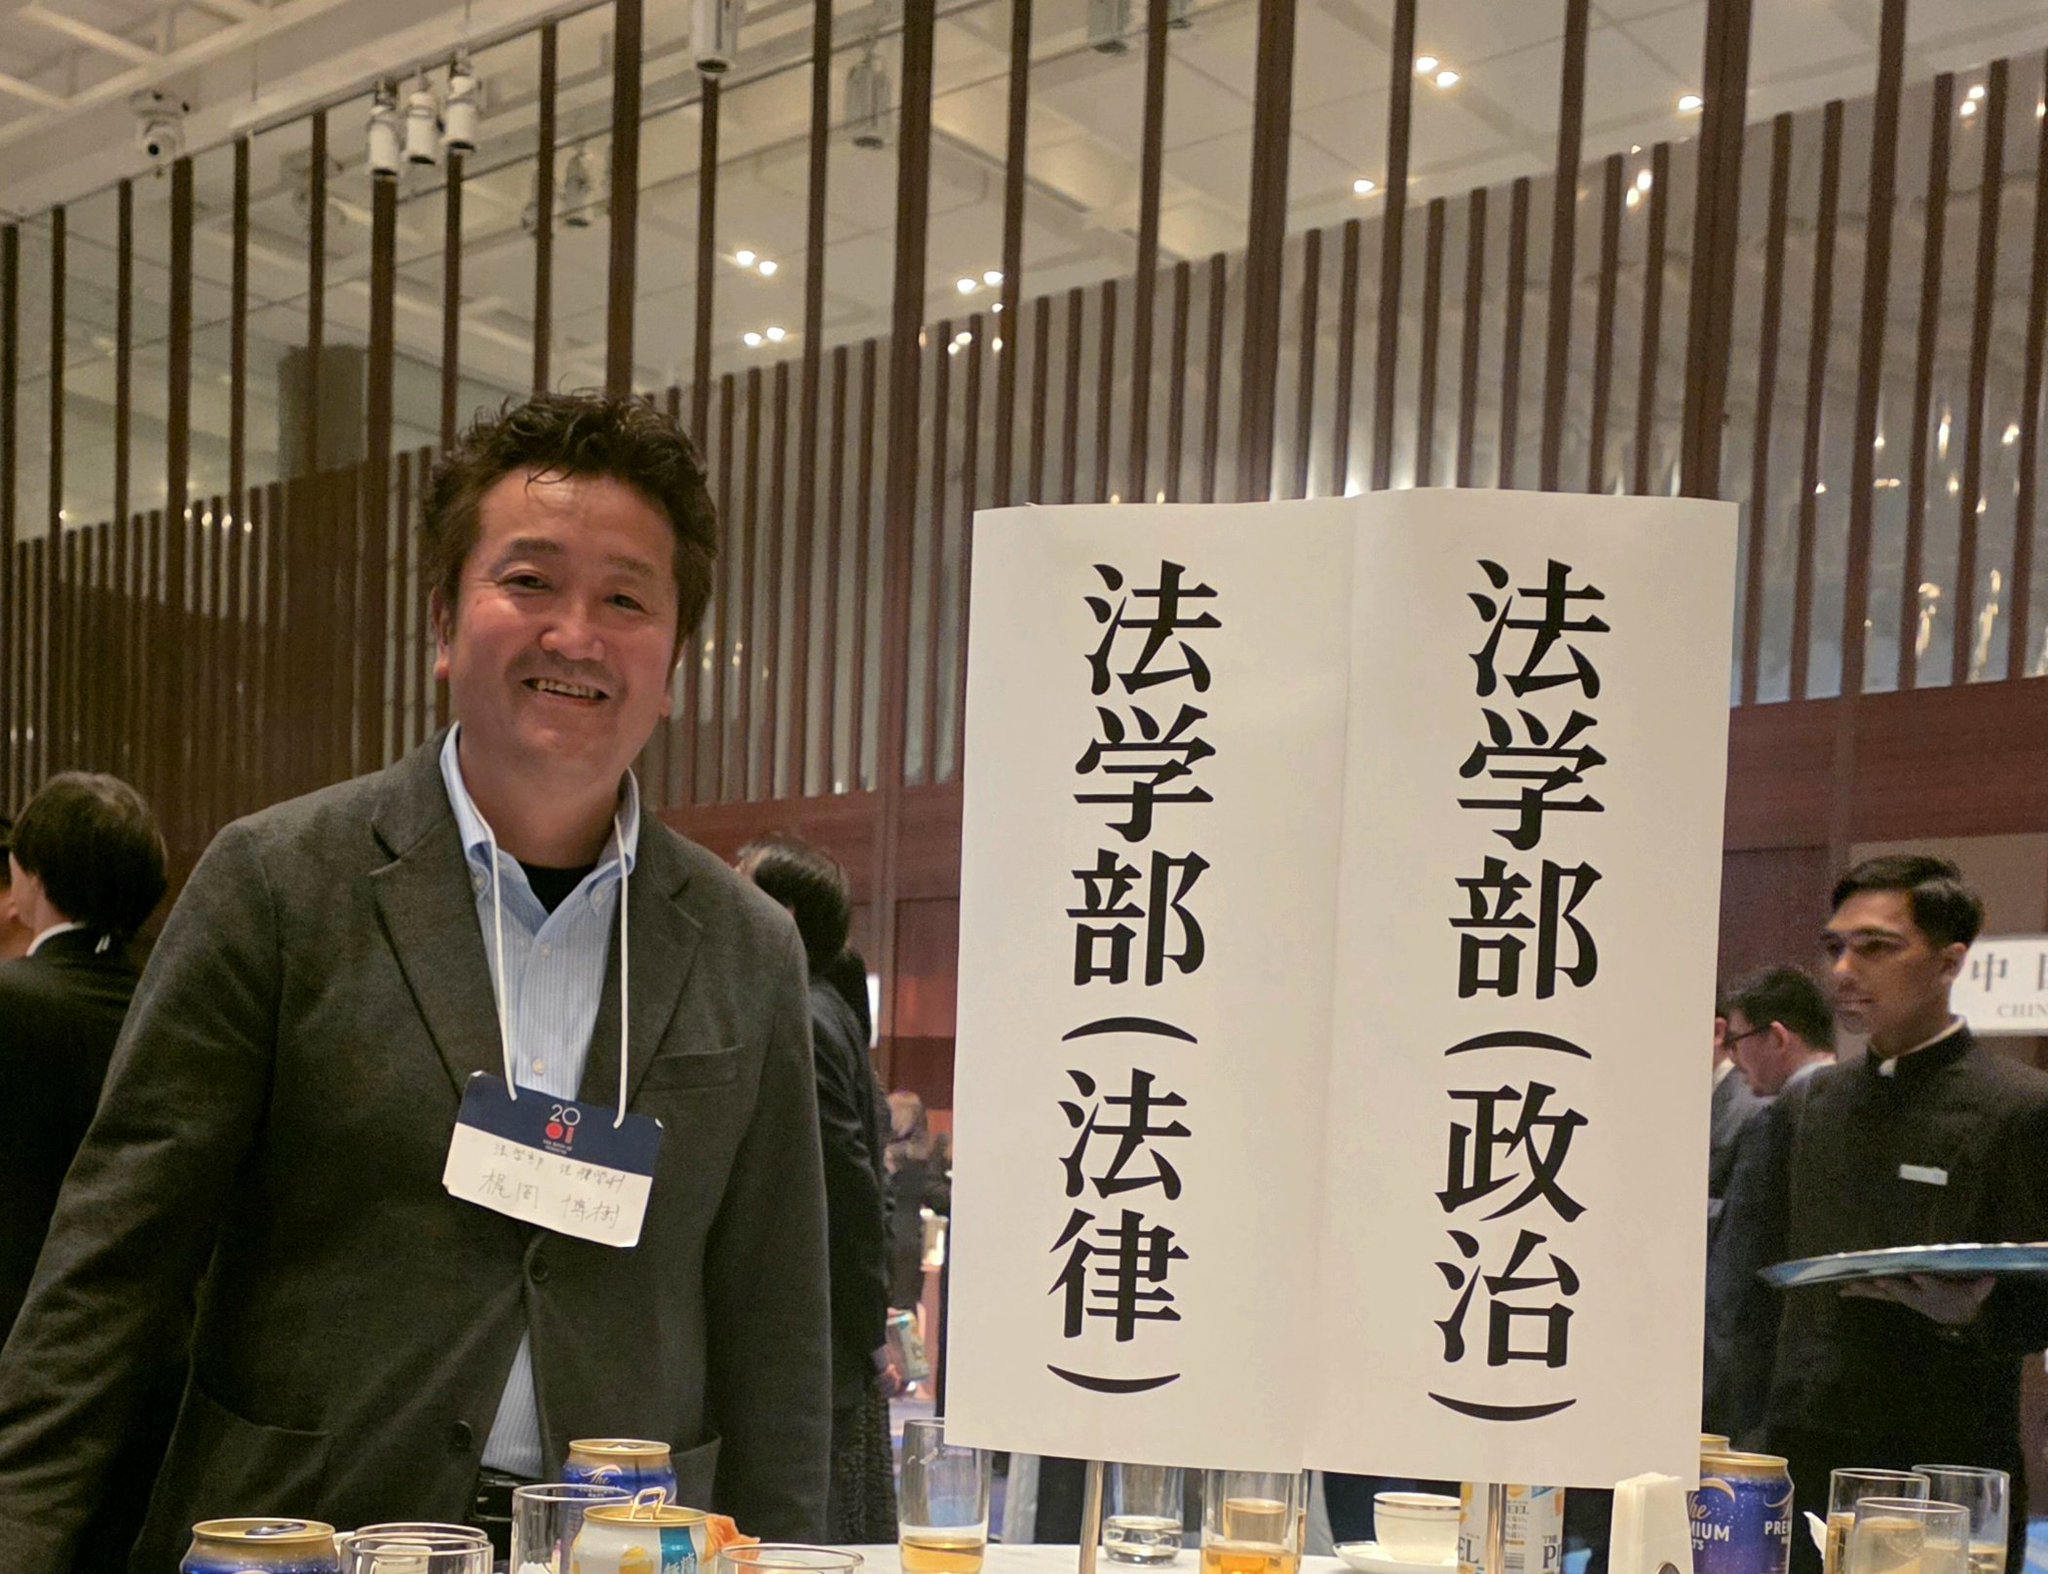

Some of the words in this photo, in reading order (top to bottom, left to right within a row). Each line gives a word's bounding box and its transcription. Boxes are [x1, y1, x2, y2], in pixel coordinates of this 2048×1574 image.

[1047, 560, 1222, 1394] 法学部（法律）
[1428, 559, 1611, 1422] 法学部（政治）
[1971, 953, 2048, 993] 中
